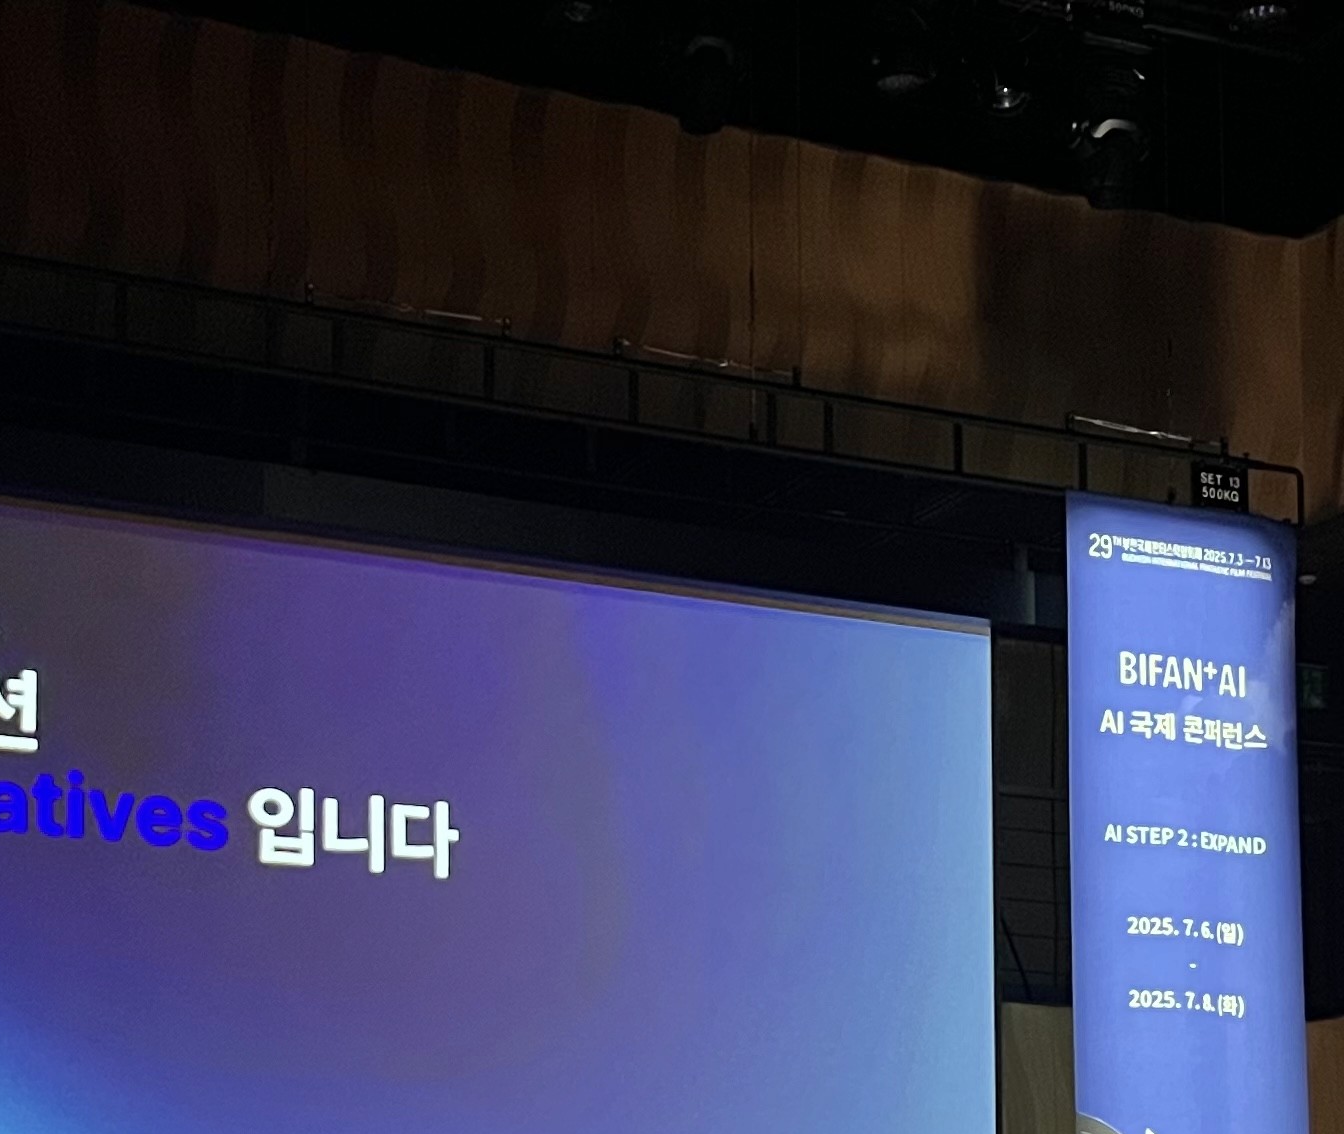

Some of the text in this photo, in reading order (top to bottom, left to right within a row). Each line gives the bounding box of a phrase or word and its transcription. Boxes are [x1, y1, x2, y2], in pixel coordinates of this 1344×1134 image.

[1200, 471, 1240, 489] SET 13
[1202, 486, 1240, 502] 500KG
[1100, 709, 1268, 750] AI 국제 콘퍼런스
[246, 785, 460, 880] 입니다
[1104, 823, 1122, 843] AI
[1126, 826, 1175, 845] STEP
[1200, 832, 1267, 855] EXPAND
